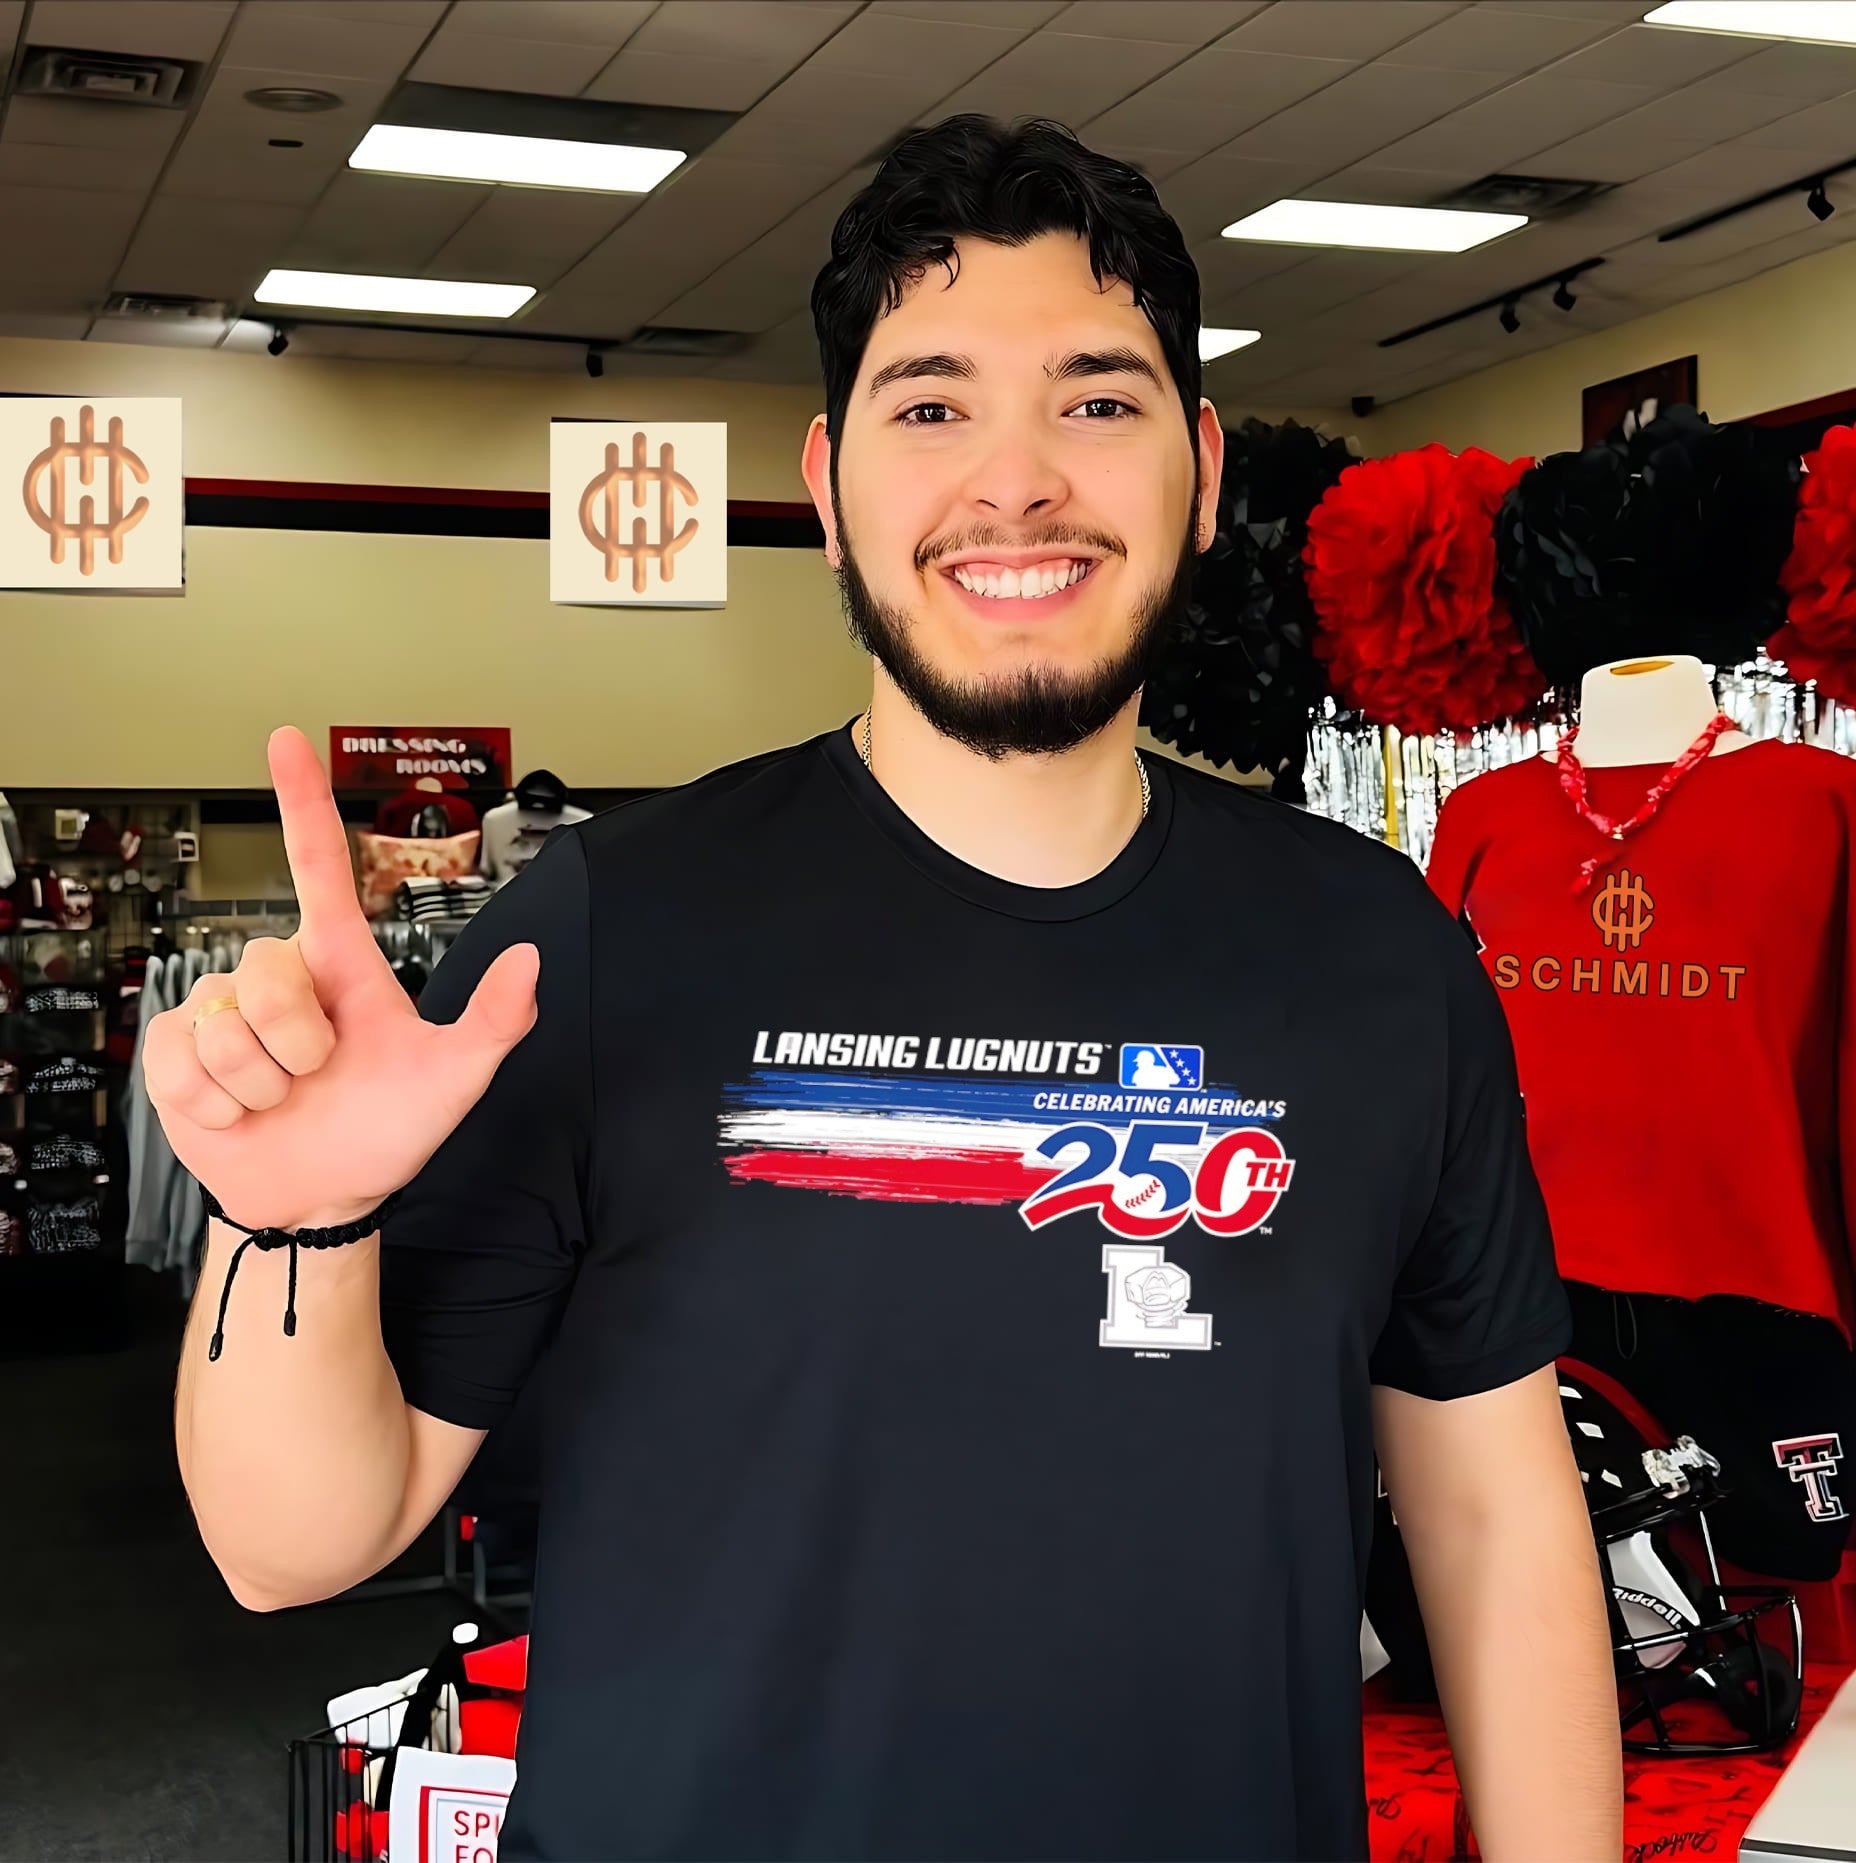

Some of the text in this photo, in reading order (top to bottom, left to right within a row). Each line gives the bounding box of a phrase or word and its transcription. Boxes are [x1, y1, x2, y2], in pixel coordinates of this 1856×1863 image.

[396, 758, 487, 775] ROOMS
[1493, 953, 1747, 1001] SCHMIDT
[752, 1030, 1104, 1075] LANSING LUGNUTS
[1033, 1091, 1288, 1118] CELEBRATING AMERICA'S
